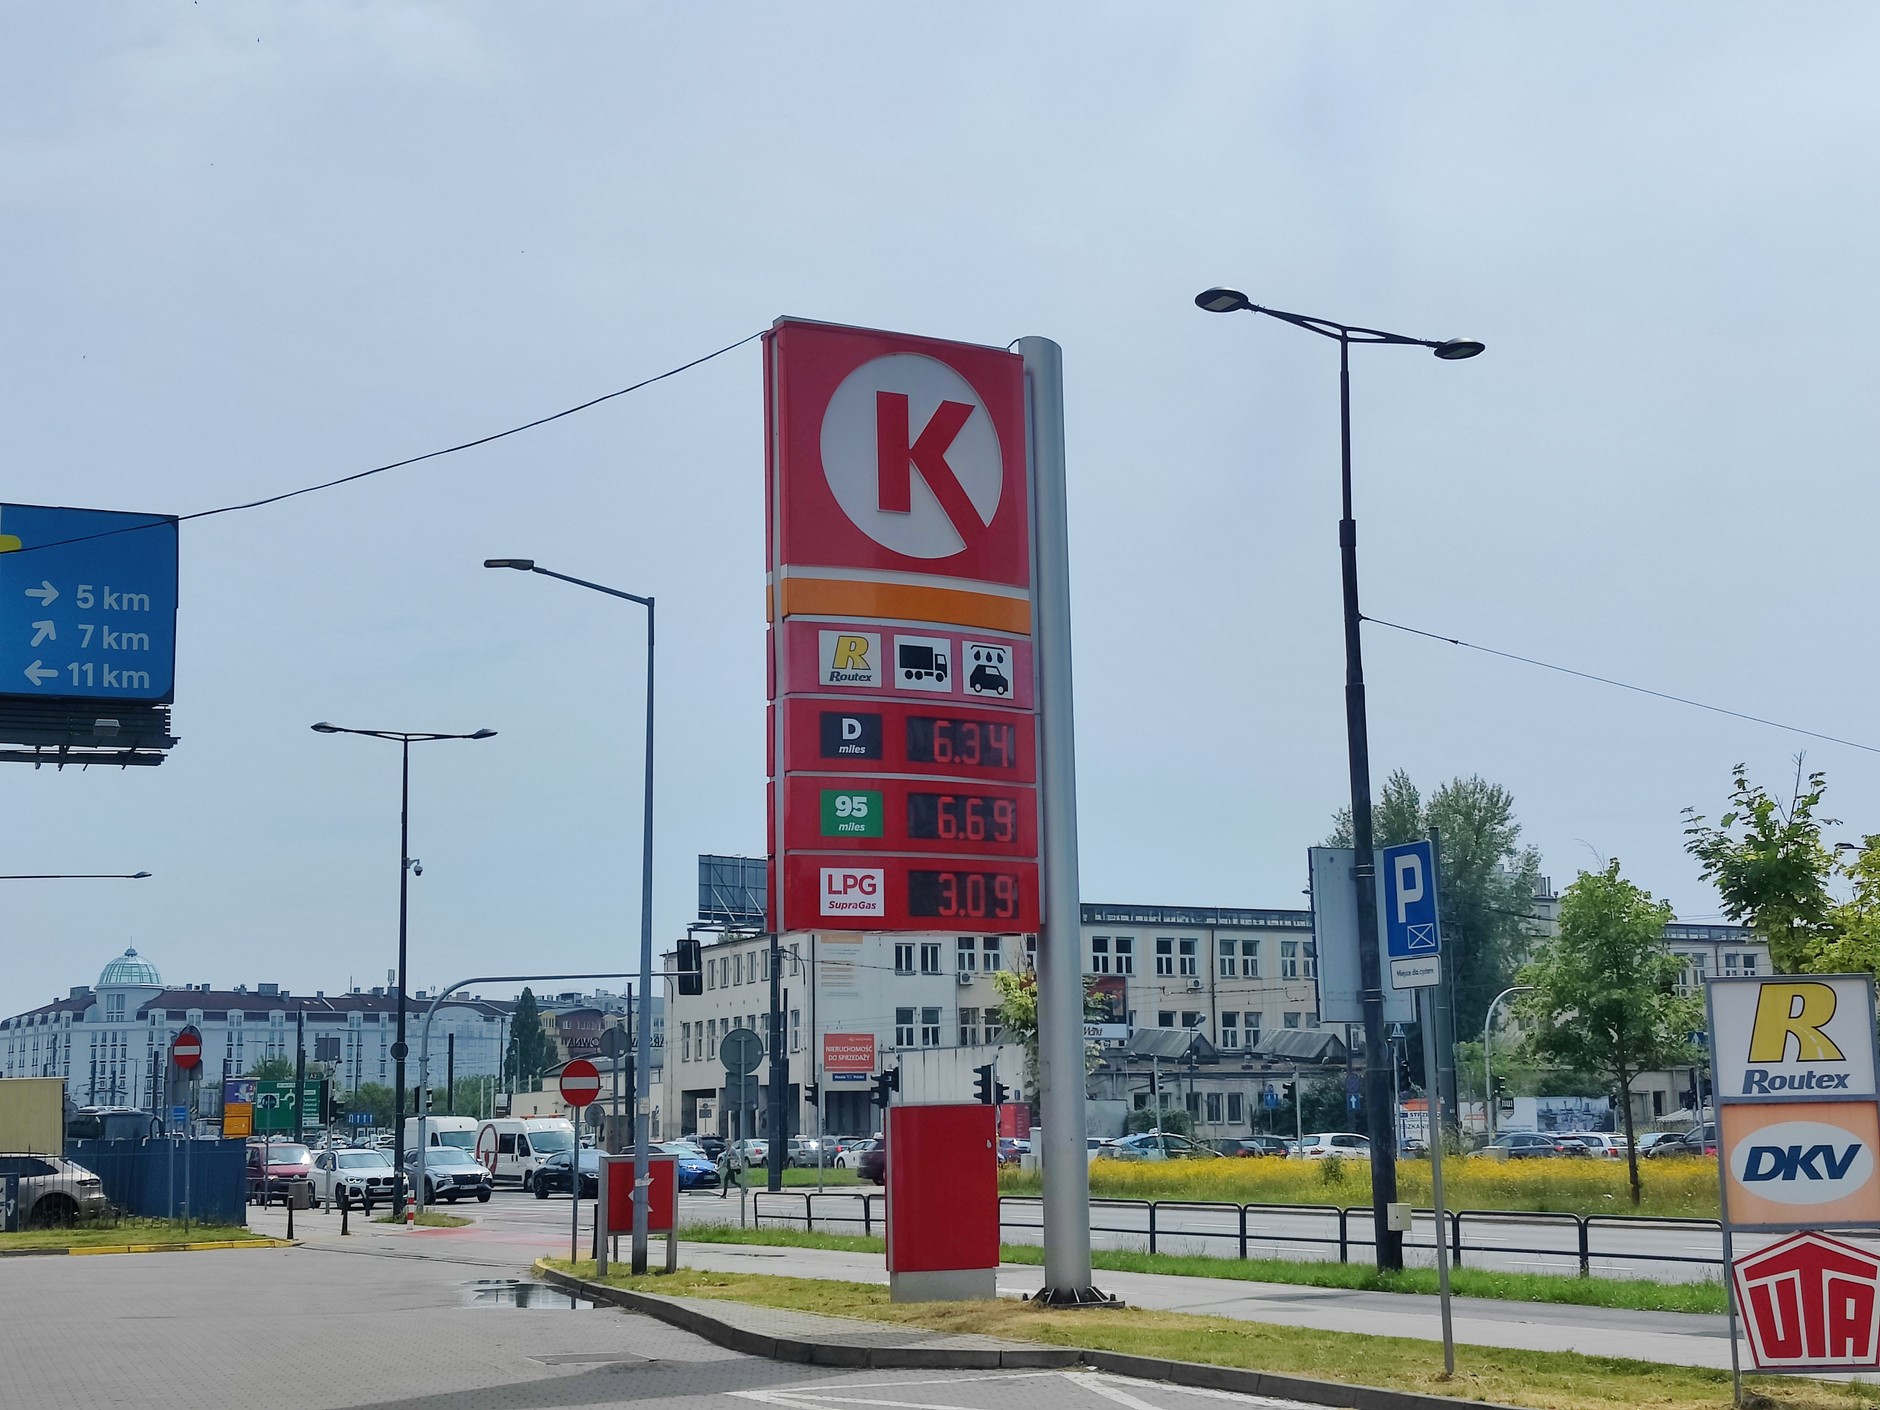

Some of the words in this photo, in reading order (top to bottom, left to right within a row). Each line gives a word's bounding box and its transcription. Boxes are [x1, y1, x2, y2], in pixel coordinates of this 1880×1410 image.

[876, 390, 988, 549] K
[76, 584, 95, 609] 5
[103, 585, 150, 612] km
[78, 624, 95, 649] 7
[102, 625, 150, 651] km
[832, 635, 872, 671] R
[66, 662, 94, 687] 11
[103, 663, 150, 689] km
[829, 671, 873, 682] Routex
[842, 717, 862, 740] D
[839, 744, 866, 754] miles
[934, 720, 1008, 768] 6.34
[835, 795, 868, 818] 95
[937, 796, 1012, 842] 6.69
[838, 822, 866, 832] miles
[827, 874, 877, 896] LPG
[938, 872, 1014, 918] 3.09
[1394, 853, 1424, 924] P
[828, 900, 877, 911] SupraGas
[1747, 982, 1847, 1063] R
[1742, 1069, 1851, 1094] Routex
[1743, 1144, 1863, 1181] DKV
[1743, 1241, 1878, 1358] UTA
